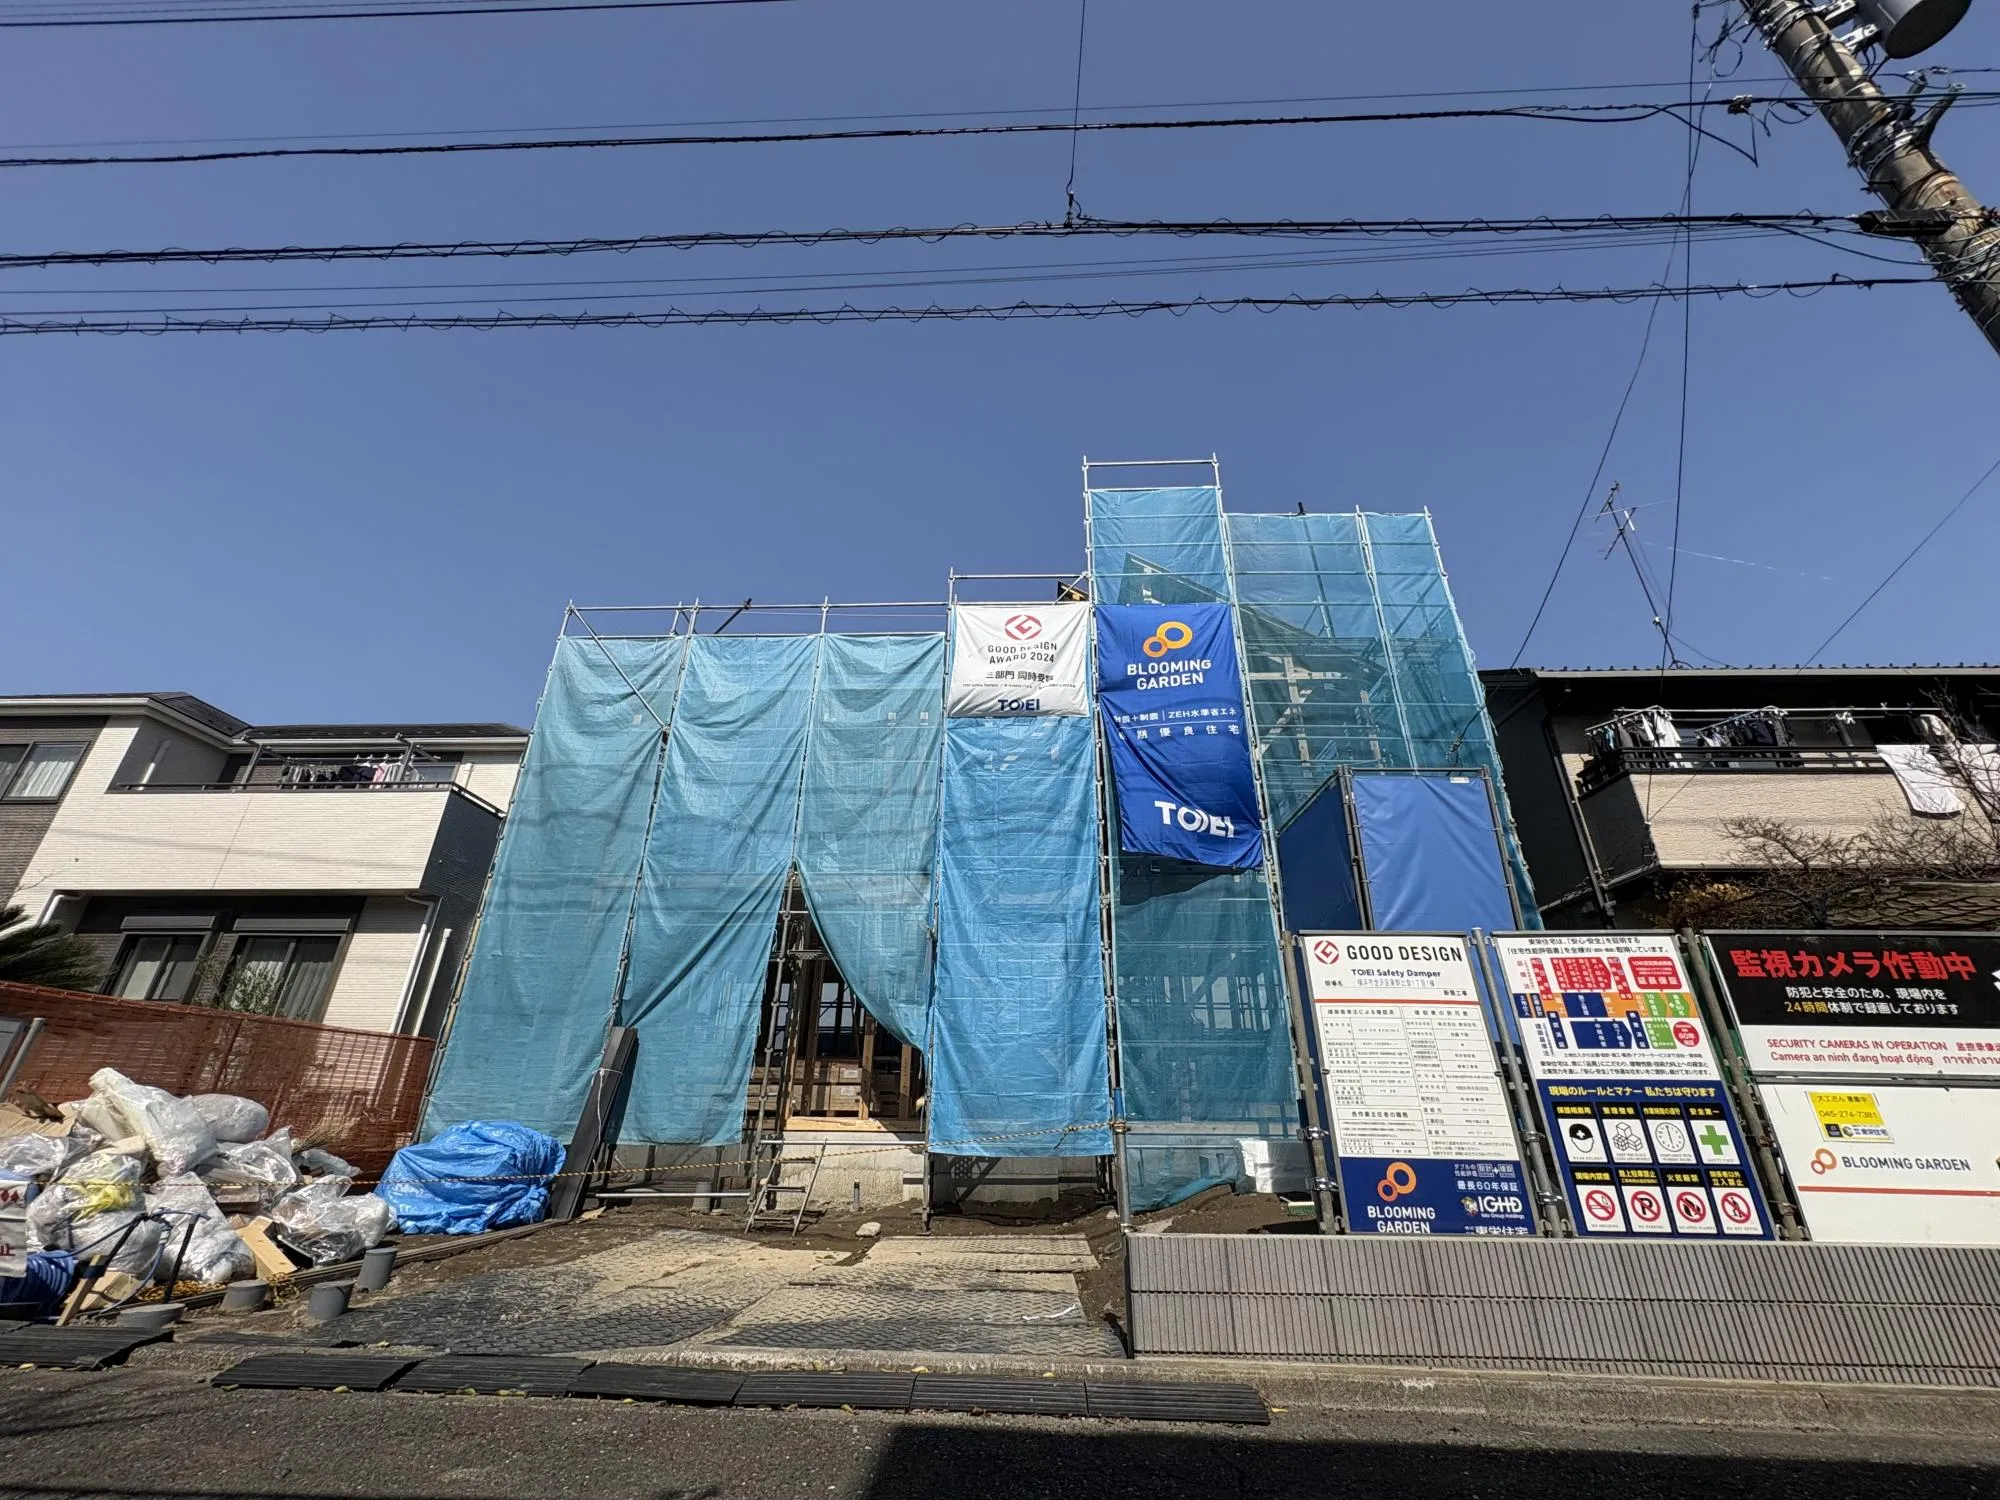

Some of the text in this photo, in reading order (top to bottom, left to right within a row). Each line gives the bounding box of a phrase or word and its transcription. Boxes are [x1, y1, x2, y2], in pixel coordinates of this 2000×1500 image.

[987, 642, 1057, 654] GOOD DIGN
[989, 652, 1055, 664] AWARD 2024
[1127, 658, 1212, 676] BLOOMING
[985, 670, 1015, 680] 三部門
[1136, 672, 1204, 690] GARDEN
[1168, 708, 1237, 719] ZEH水準省エネ
[1346, 945, 1463, 962] GOOD DESIGN
[1729, 949, 1978, 982] 監視カメラ作動中
[1377, 968, 1404, 978] Safety
[1406, 970, 1441, 978] Damper
[1785, 986, 1948, 1000] 防犯と安全のため、現場内を
[1784, 1000, 1960, 1016] 24時間体制で録画しております
[1766, 1038, 1948, 1051] SECURITY CAMERAS IN OPERATION
[1770, 1052, 1934, 1066] Camera an ninh đang hoạt động
[1548, 1086, 1717, 1098] 現場のルールとマナー 私たちは守ります
[1842, 1156, 1972, 1171] BLOOMING GARDEN
[1457, 1180, 1519, 1192] 最長60年保証
[1367, 1205, 1436, 1220] BLOOMING
[1377, 1220, 1431, 1234] GARDEN
